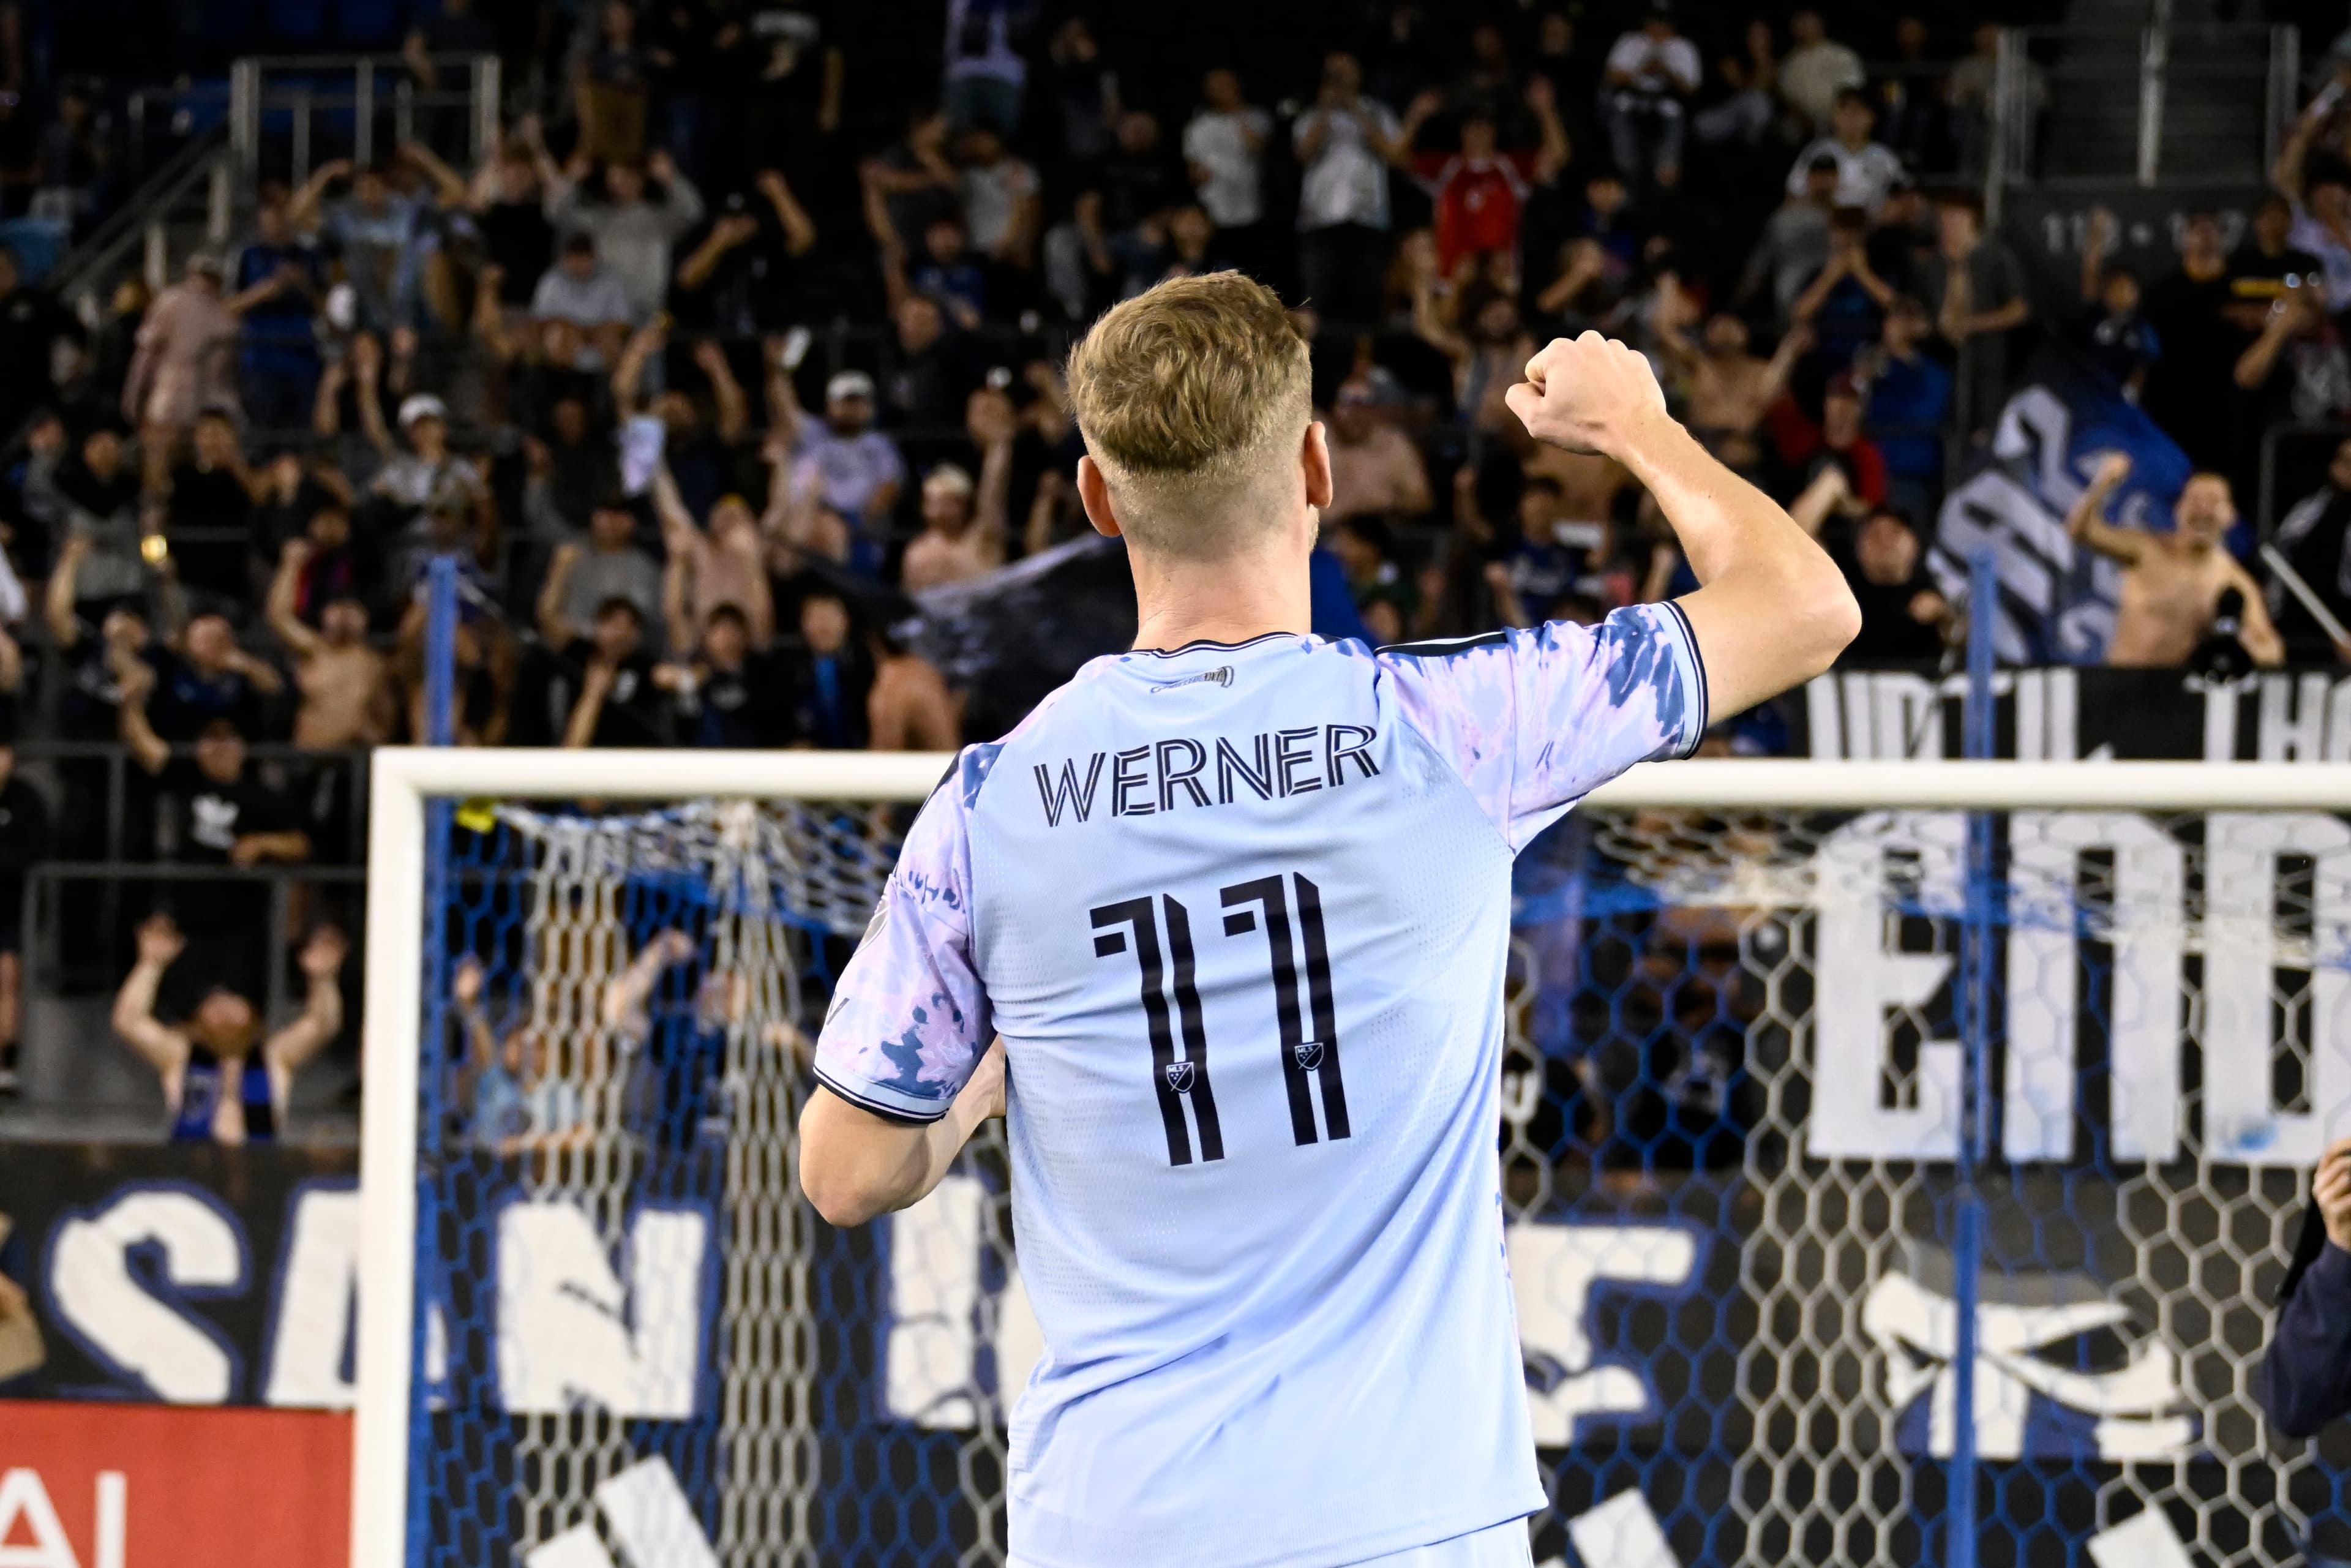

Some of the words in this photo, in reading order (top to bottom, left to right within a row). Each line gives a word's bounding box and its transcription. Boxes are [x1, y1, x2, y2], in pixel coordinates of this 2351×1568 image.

[2182, 671, 2351, 761] TH
[1033, 724, 1381, 828] WERNER
[1090, 871, 1351, 1166] 11
[1168, 1065, 1184, 1073] MLS
